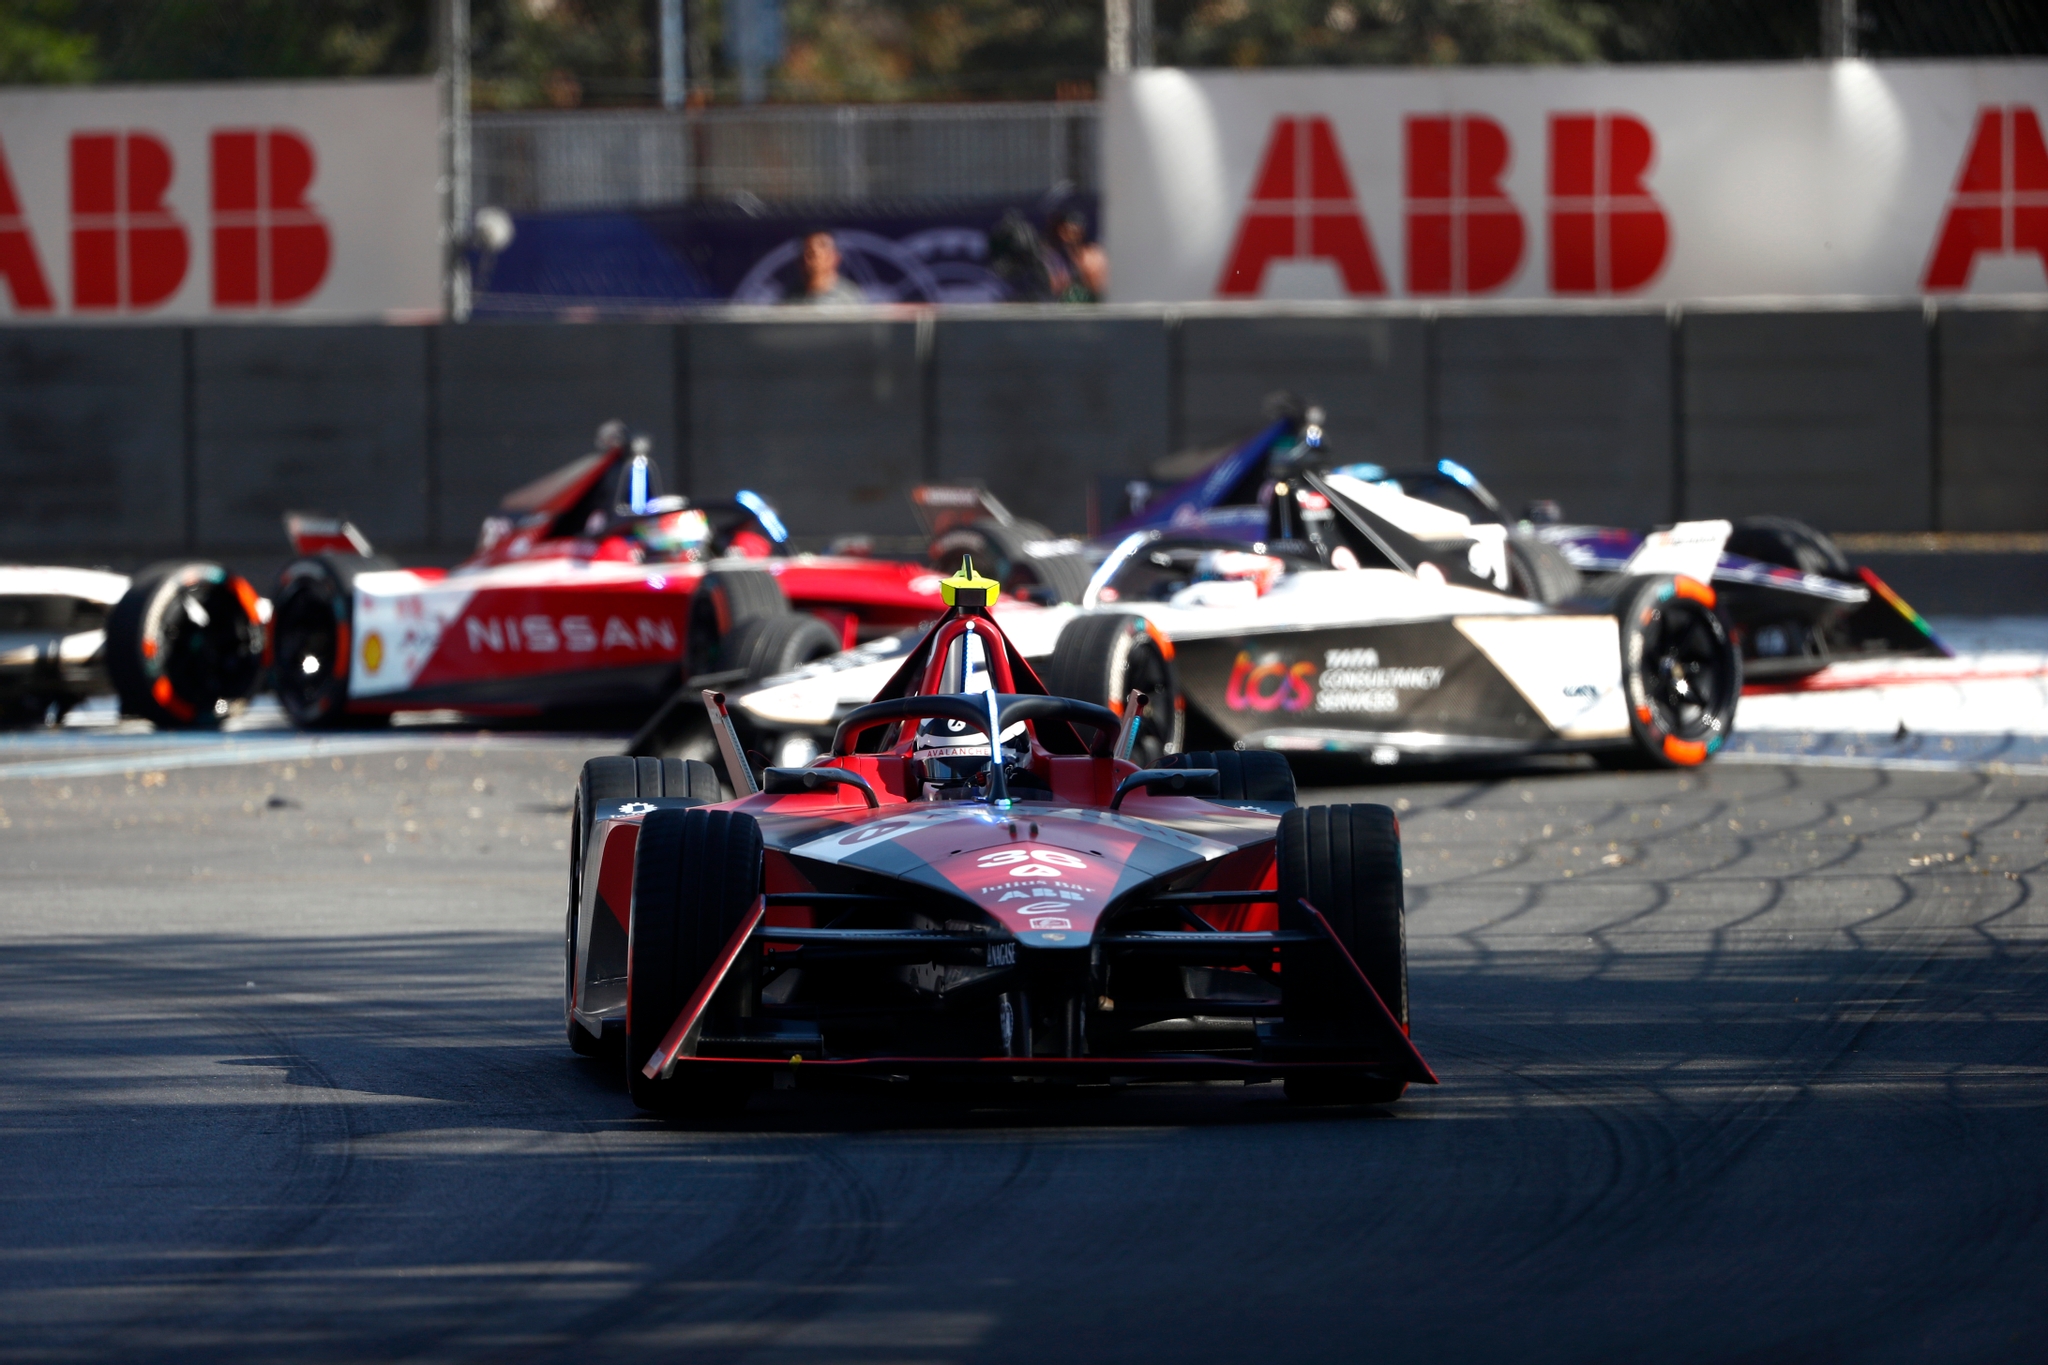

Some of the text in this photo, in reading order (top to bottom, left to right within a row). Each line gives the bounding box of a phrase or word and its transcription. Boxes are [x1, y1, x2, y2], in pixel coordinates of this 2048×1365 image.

[1216, 114, 1672, 298] ABB
[466, 614, 676, 652] NISSAN
[1319, 667, 1446, 690] CONSULTANCY
[1317, 689, 1401, 712] SERVICES
[926, 747, 989, 758] AVALANCHE
[977, 850, 1087, 868] 36
[998, 888, 1084, 902] ABB
